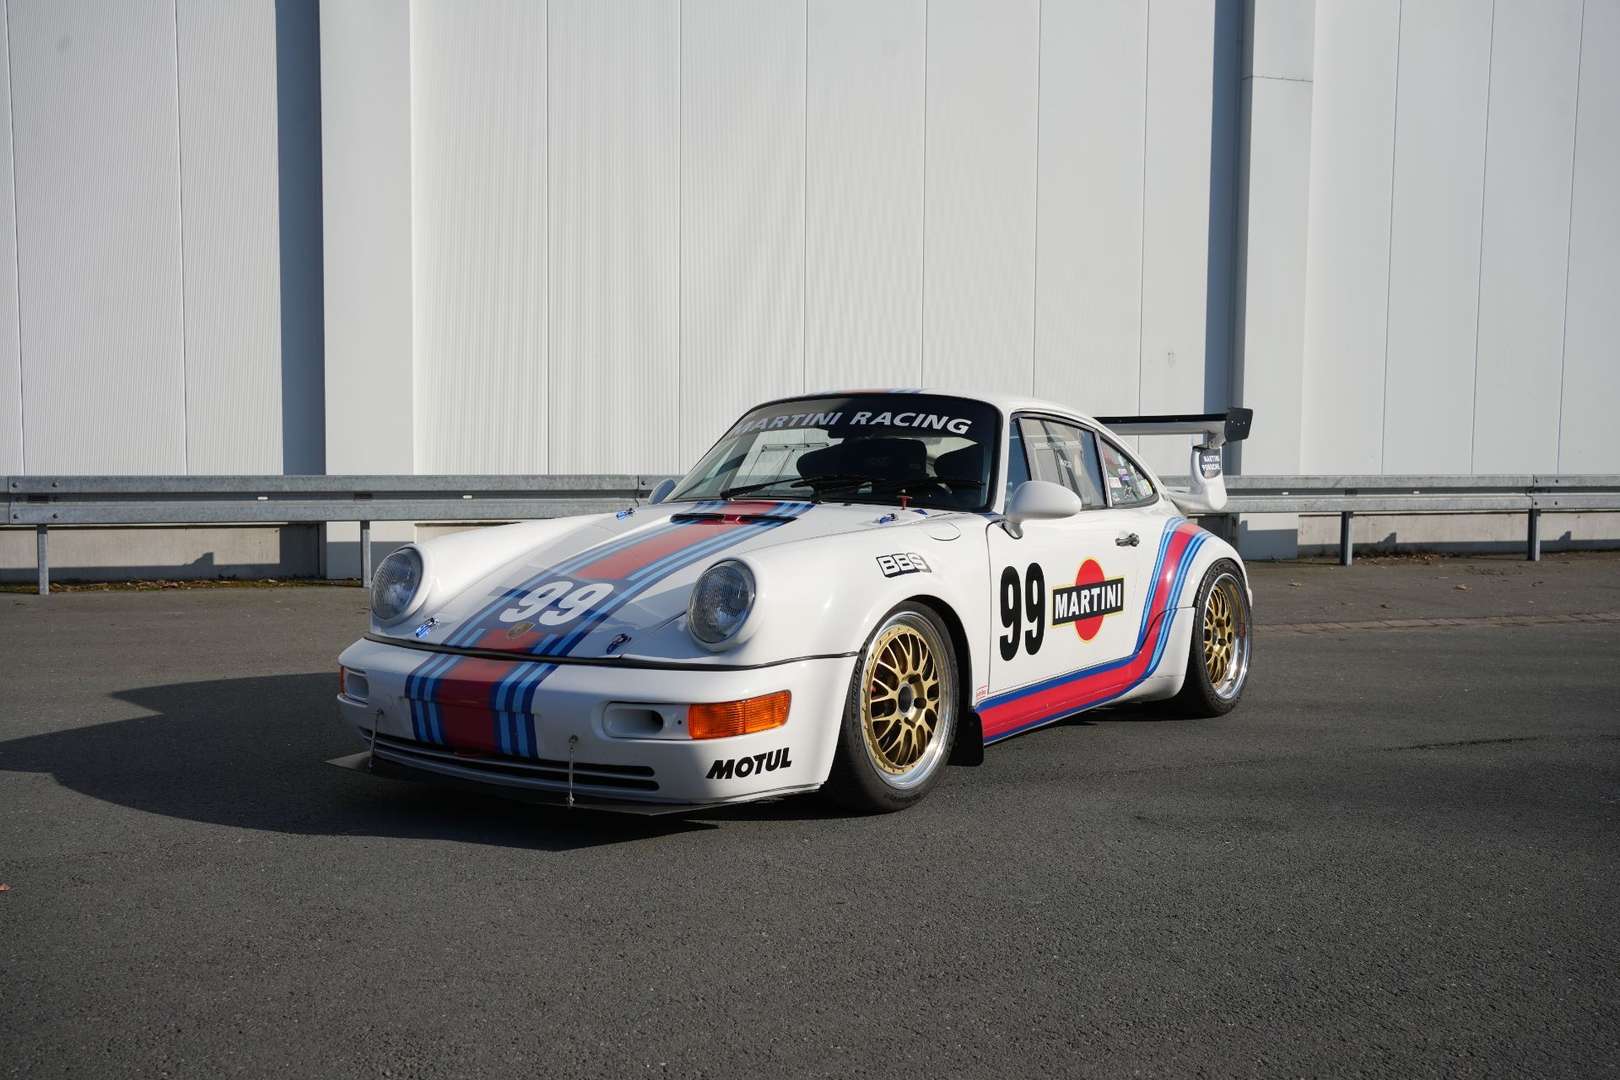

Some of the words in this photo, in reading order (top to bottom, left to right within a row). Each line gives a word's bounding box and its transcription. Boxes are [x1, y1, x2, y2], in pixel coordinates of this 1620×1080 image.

[850, 411, 972, 435] RACING
[876, 552, 932, 578] BBS
[499, 581, 614, 626] 99
[1000, 562, 1045, 662] 99
[1055, 583, 1121, 620] MARTINI
[705, 747, 792, 780] MOTUL
